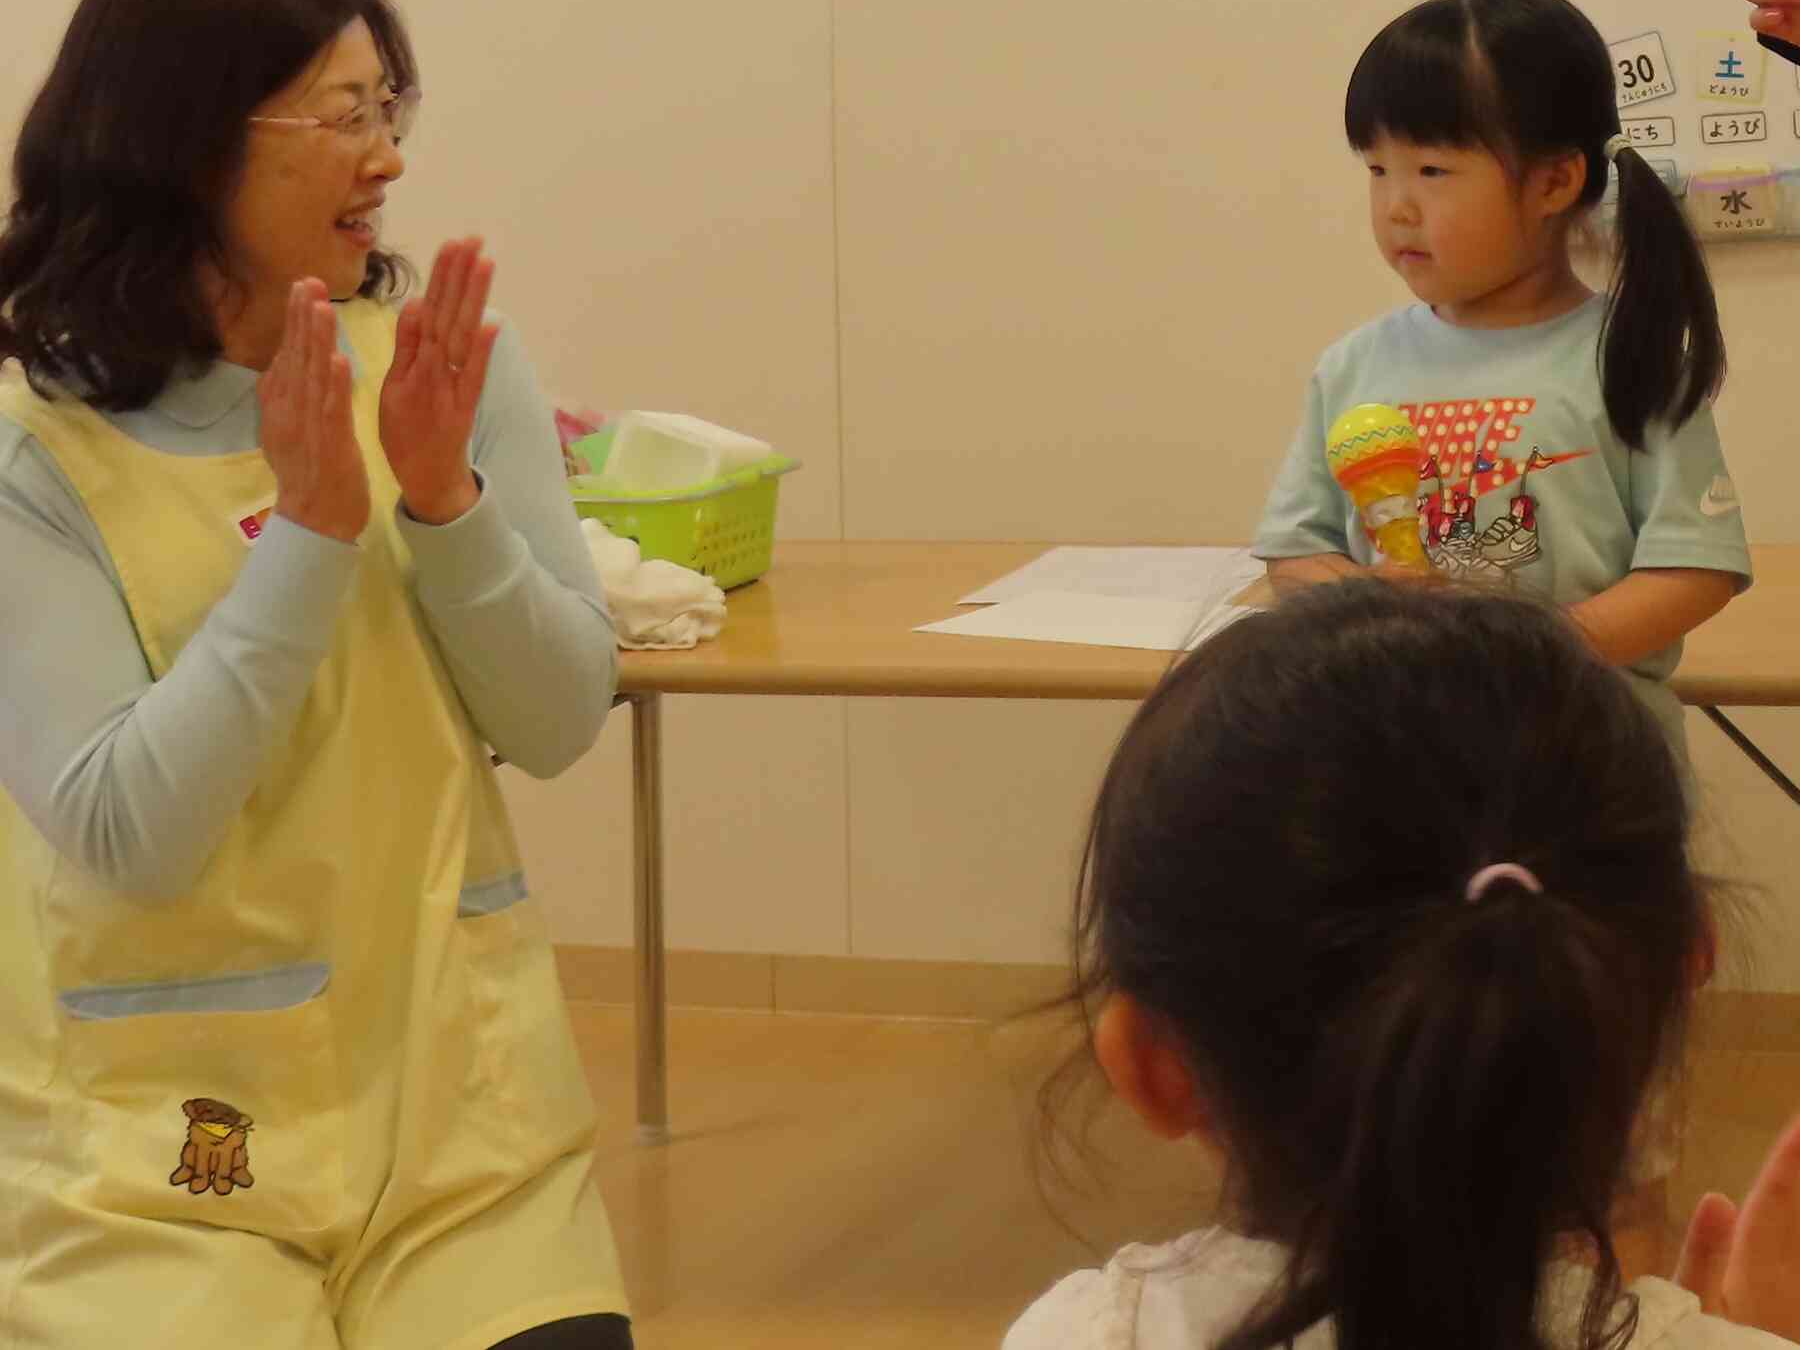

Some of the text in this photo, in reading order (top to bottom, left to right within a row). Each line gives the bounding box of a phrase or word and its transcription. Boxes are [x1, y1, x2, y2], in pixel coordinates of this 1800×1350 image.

[1618, 54, 1655, 88] 30
[1715, 51, 1744, 79] 土
[1709, 83, 1750, 97] どようび
[1709, 118, 1760, 138] ようび
[1720, 189, 1753, 215] 水
